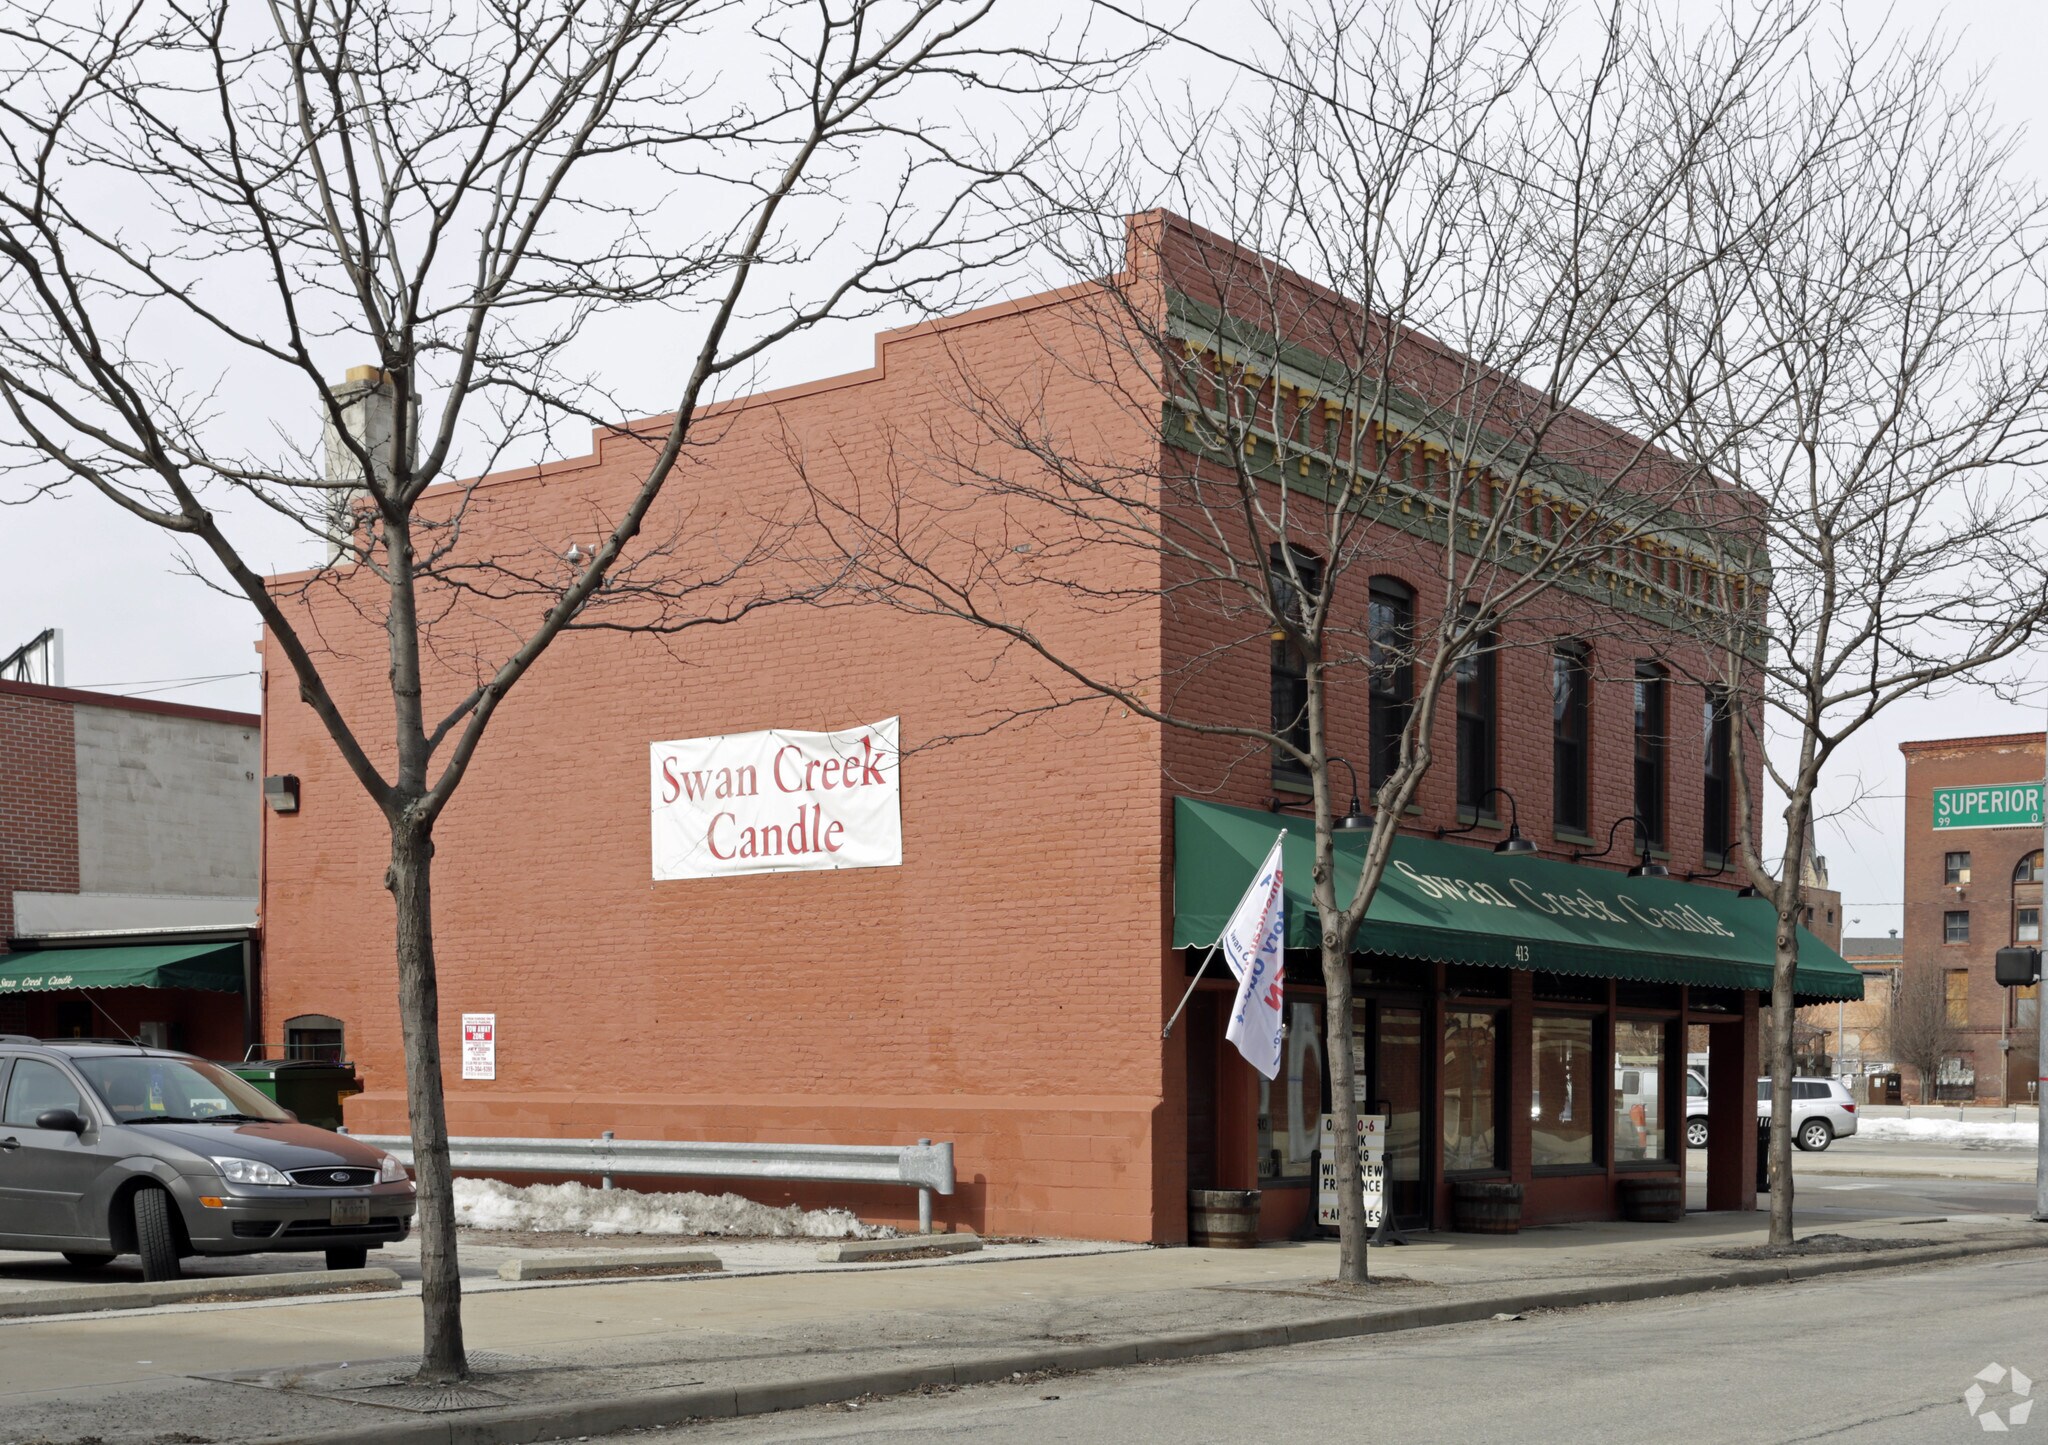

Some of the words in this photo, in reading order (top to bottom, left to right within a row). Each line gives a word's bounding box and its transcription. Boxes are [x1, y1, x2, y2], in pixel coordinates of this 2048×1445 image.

[662, 756, 759, 804] Swan
[773, 734, 886, 793] Creek
[1938, 788, 2039, 816] SUPERIOR
[1938, 817, 1951, 827] 99
[2031, 812, 2038, 823] 0
[707, 802, 844, 861] Candle
[1393, 859, 1516, 909] Swan
[1508, 878, 1629, 924] Creek
[1617, 893, 1735, 939] Candle
[1515, 945, 1530, 962] 413
[0, 978, 17, 988] Swan
[22, 977, 43, 987] Creek
[48, 975, 73, 985] Candle
[1357, 1119, 1375, 1132] 0-6
[1323, 1178, 1381, 1192] FRNCE
